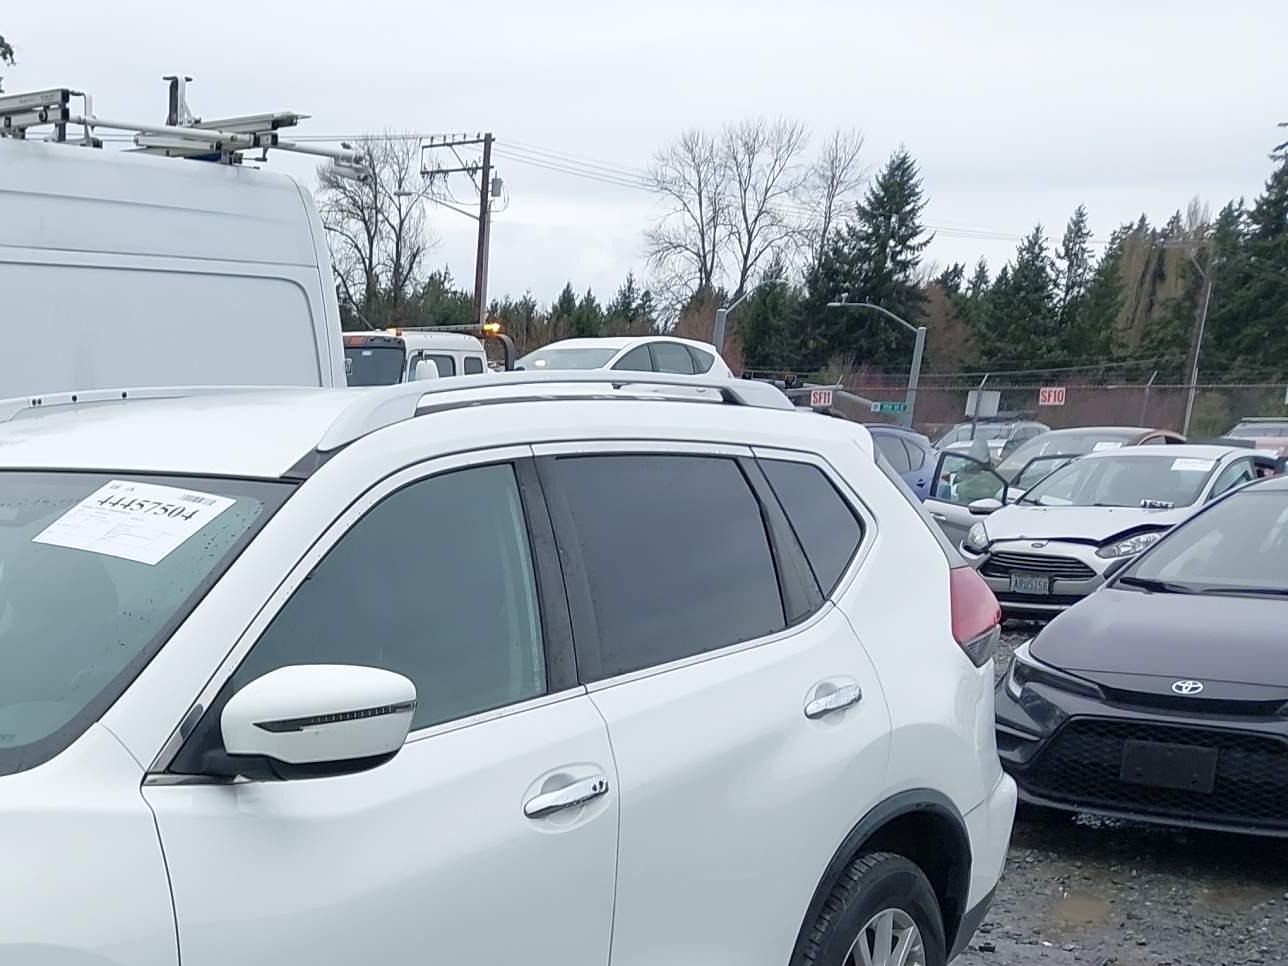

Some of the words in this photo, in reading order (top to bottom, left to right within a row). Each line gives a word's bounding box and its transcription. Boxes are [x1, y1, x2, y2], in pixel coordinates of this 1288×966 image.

[812, 391, 831, 405] SF11
[1040, 389, 1064, 403] SF10
[97, 494, 200, 521] 44457504
